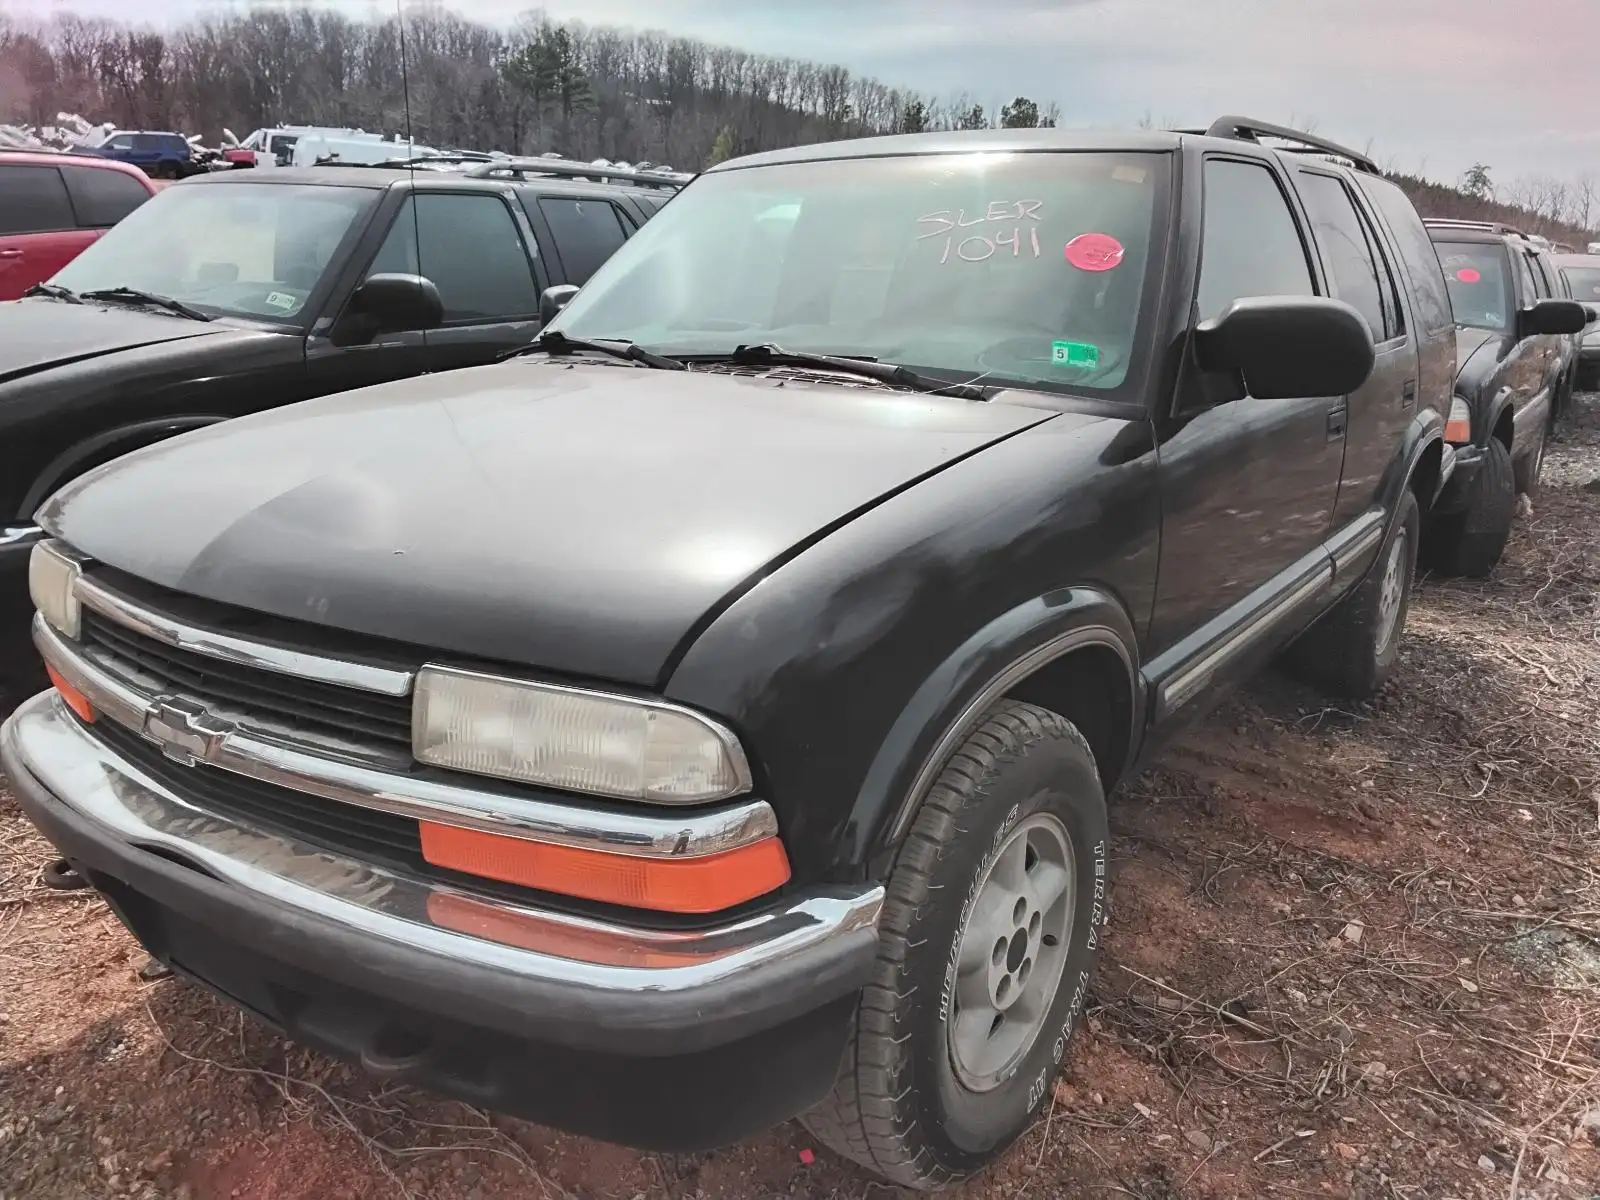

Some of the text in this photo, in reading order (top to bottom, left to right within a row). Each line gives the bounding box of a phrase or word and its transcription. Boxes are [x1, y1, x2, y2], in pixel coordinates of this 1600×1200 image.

[940, 227, 1040, 264] 1041
[1056, 348, 1065, 360] 5
[1086, 840, 1105, 951] TERRA
